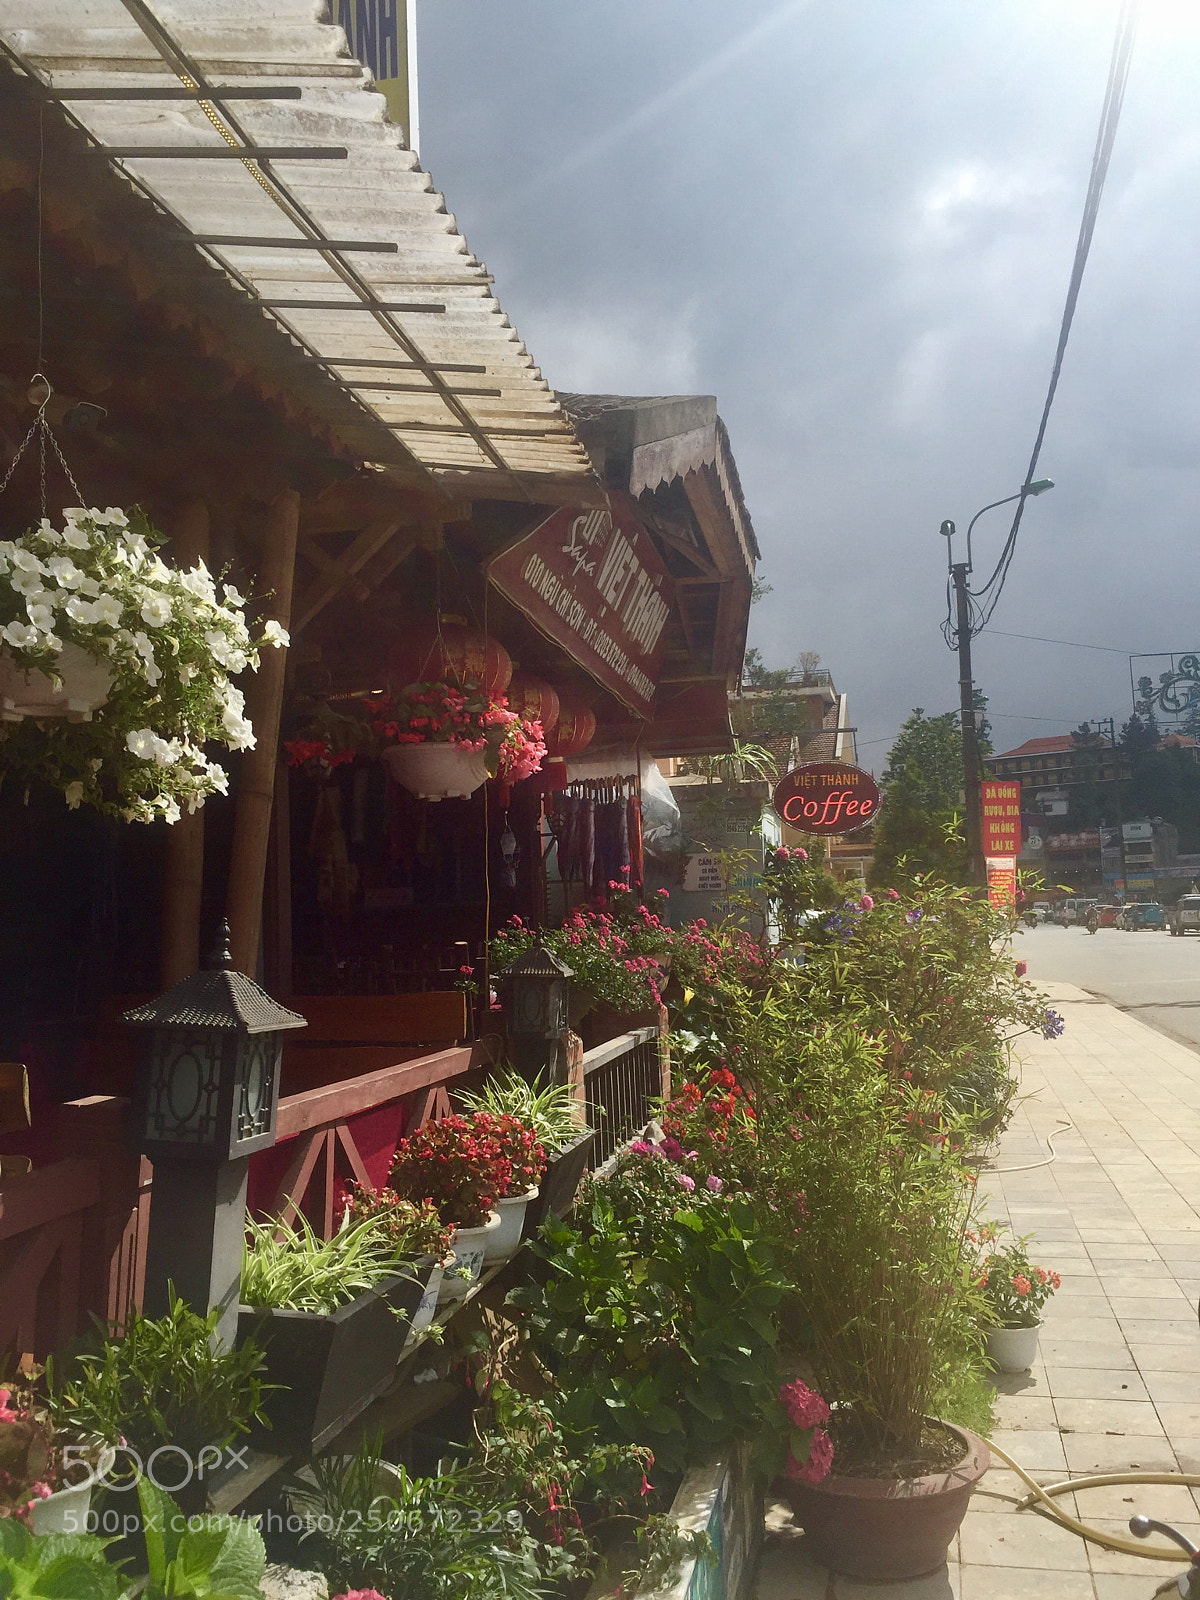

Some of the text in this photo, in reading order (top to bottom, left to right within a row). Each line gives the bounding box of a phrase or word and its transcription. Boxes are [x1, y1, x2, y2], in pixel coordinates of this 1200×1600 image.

[794, 772, 818, 788] VIỆT
[783, 790, 873, 825] Coffee
[1004, 840, 1015, 851] XE
